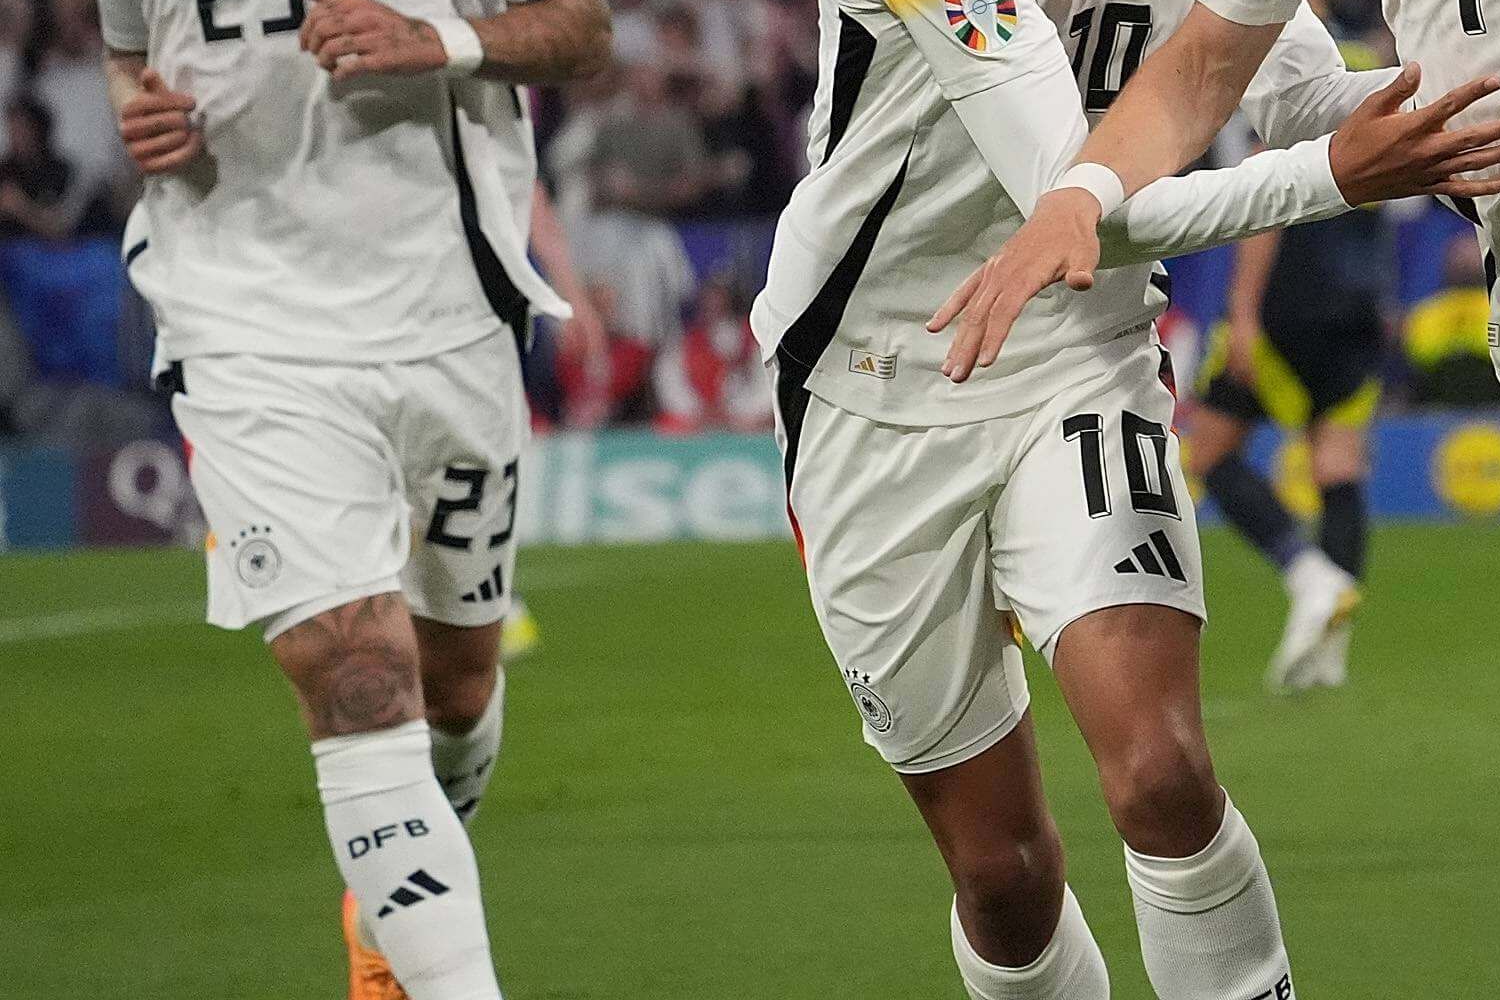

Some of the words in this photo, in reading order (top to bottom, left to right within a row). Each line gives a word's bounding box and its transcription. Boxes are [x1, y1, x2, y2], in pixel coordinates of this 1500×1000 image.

[1069, 3, 1153, 114] 10
[425, 458, 519, 549] 23
[1062, 409, 1182, 521] 10
[348, 819, 430, 859] DFB
